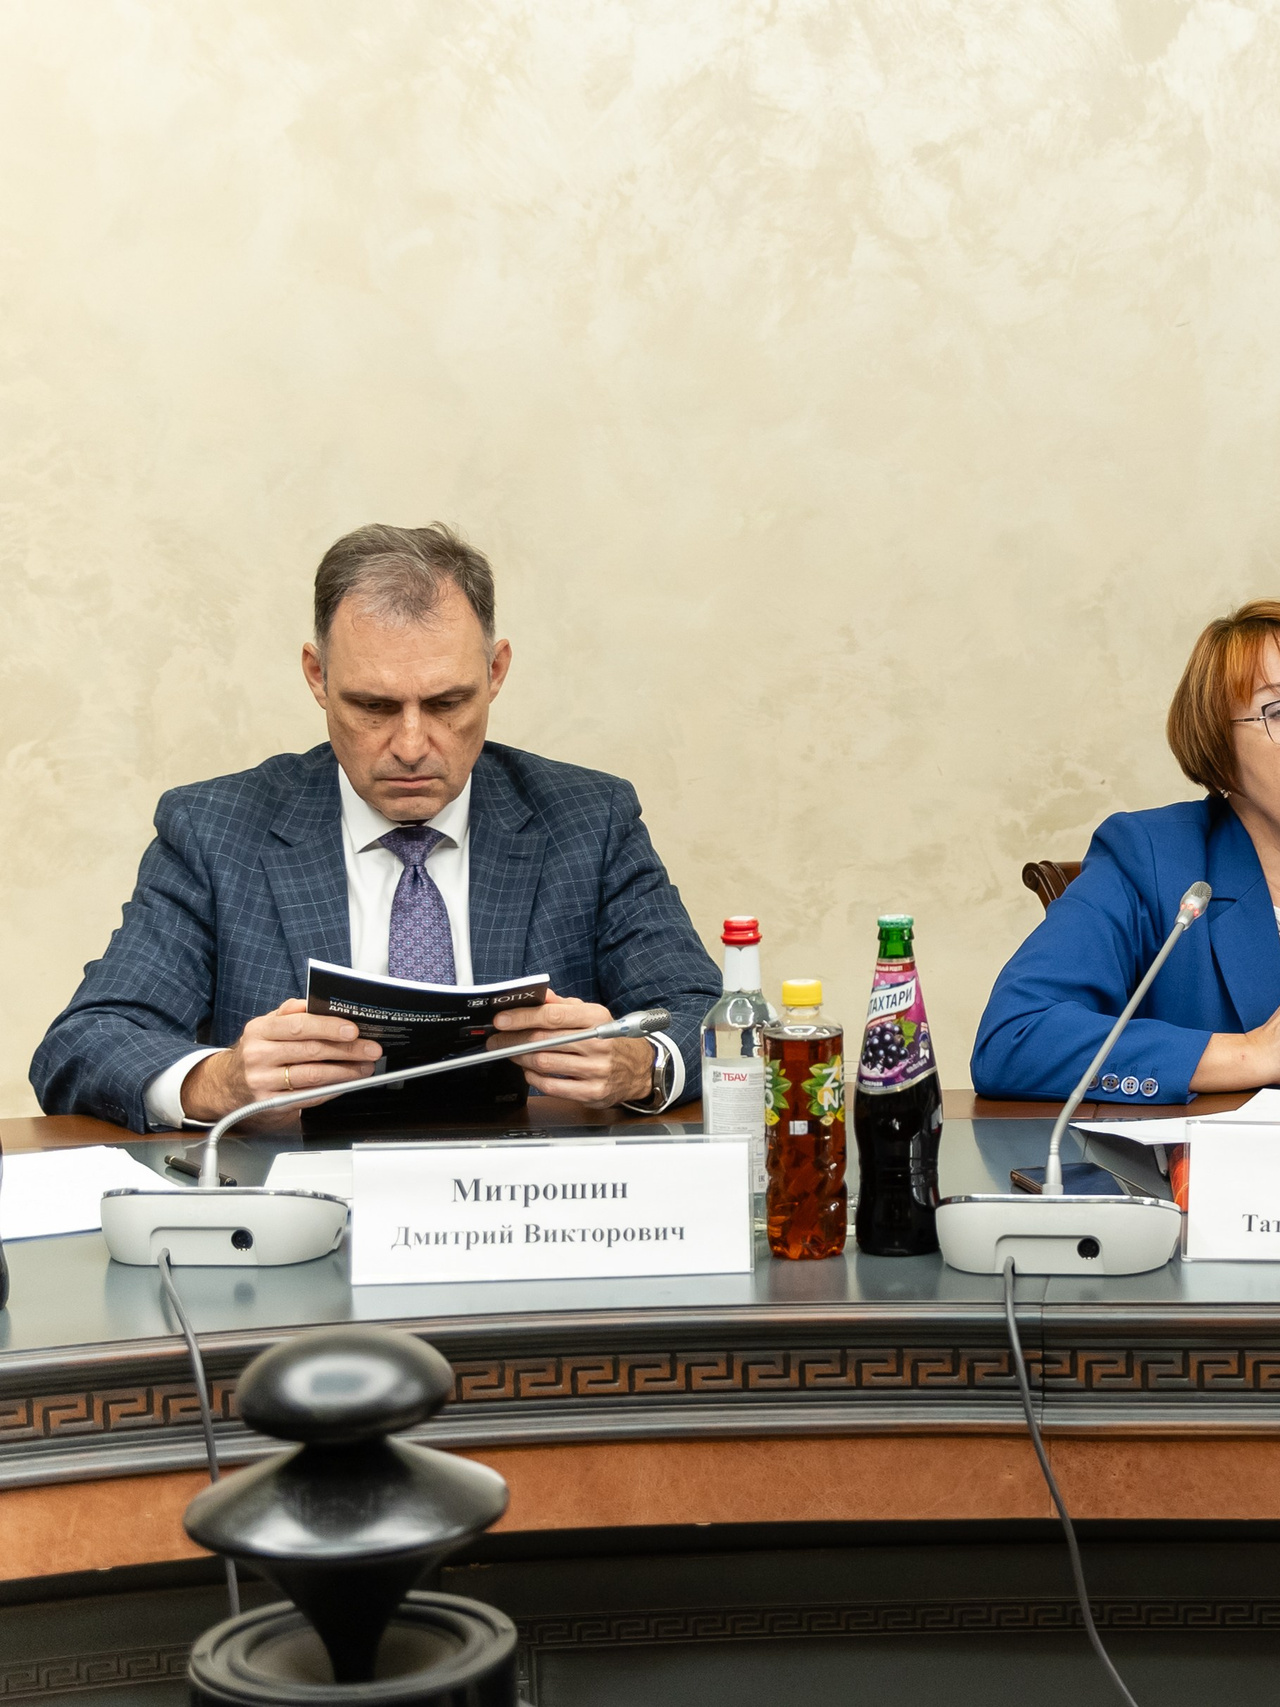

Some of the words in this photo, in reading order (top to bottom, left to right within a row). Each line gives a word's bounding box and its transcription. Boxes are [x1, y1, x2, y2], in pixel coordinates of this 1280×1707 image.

[329, 1000, 359, 1012] НАШЕ
[360, 1006, 442, 1018] ОБОРУДОВАНИЕ
[329, 1005, 350, 1014] ДЛЯ
[352, 1010, 389, 1021] ВАШЕЙ
[391, 1015, 471, 1023] БЕЗОПАСНОСТИ
[451, 1178, 629, 1208] Митрошин
[391, 1225, 514, 1250] Дмитрий
[524, 1223, 685, 1248] Викторович
